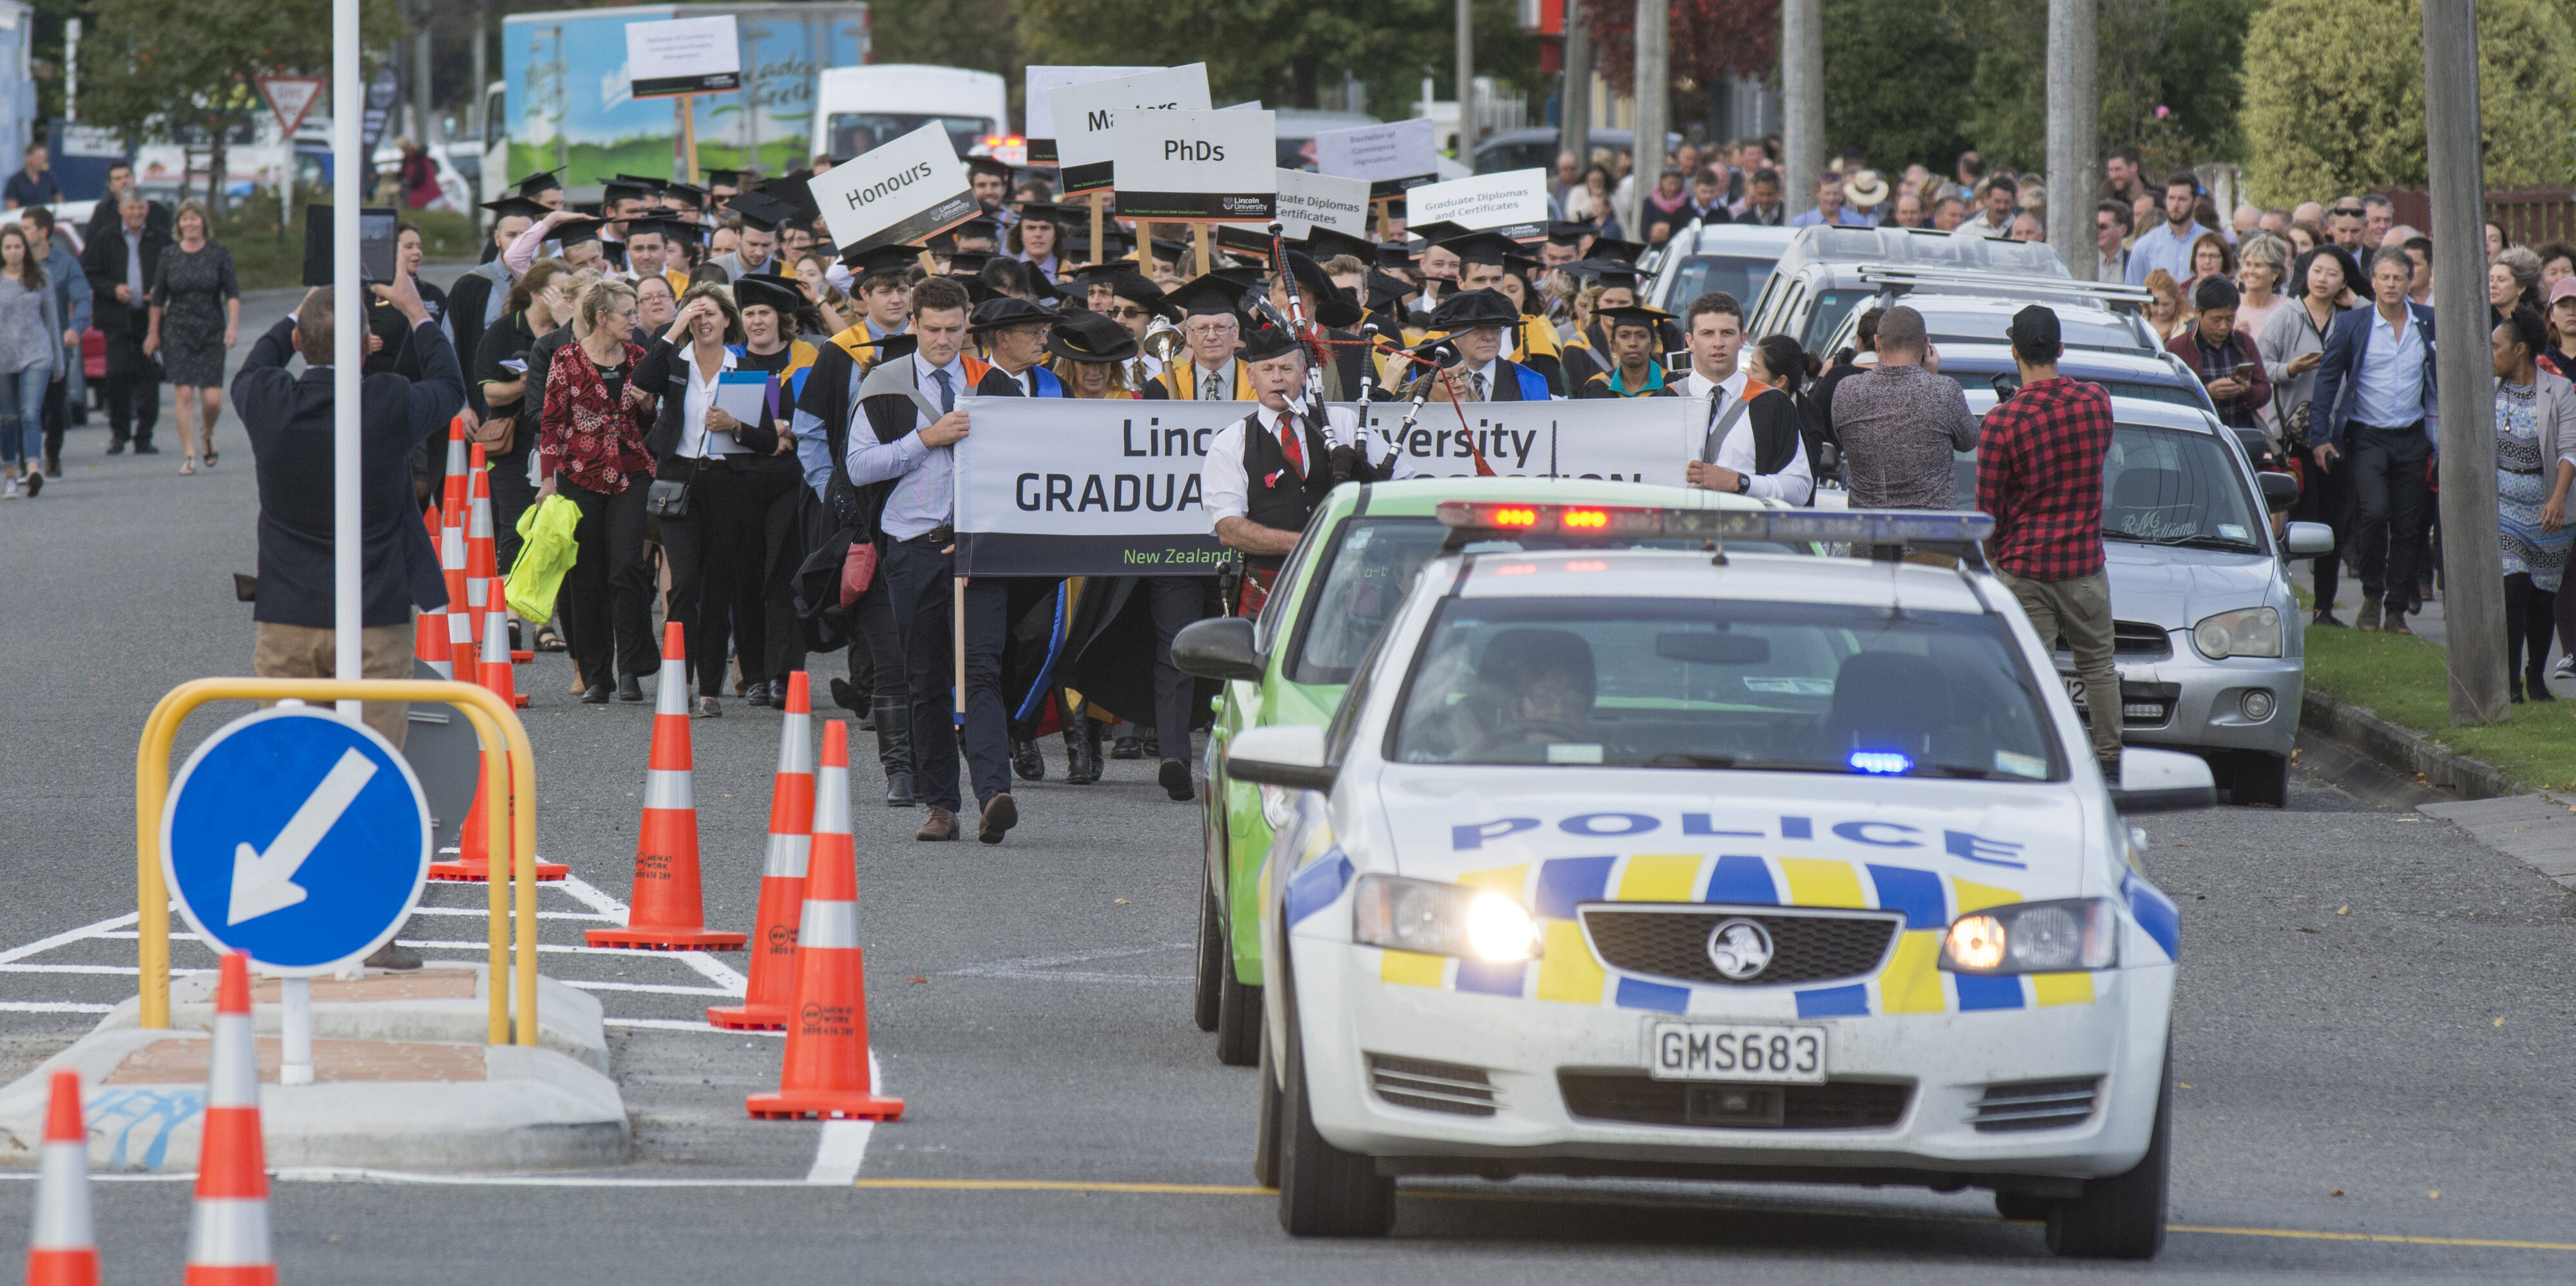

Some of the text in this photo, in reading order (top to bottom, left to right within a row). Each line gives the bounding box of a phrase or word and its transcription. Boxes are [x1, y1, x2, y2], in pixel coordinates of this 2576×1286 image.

[1350, 134, 1384, 143] Bachelor
[1165, 139, 1225, 161] PhDs
[1352, 144, 1396, 155] Commerce
[846, 161, 932, 211] Honours
[938, 199, 961, 213] Lincoln
[1234, 203, 1268, 211] University
[1307, 196, 1360, 213] Diplomas
[1425, 188, 1529, 211] Graduate Diplomas
[940, 201, 970, 218] University
[1276, 205, 1337, 224] Certificates
[1435, 202, 1520, 221] and Certificates
[1123, 417, 1225, 457] Linc
[1016, 472, 1204, 513] GRADUA
[1124, 547, 1245, 565] New Zealand's
[1452, 812, 2027, 870] POLICE
[1661, 1032, 1818, 1072] GMS683
